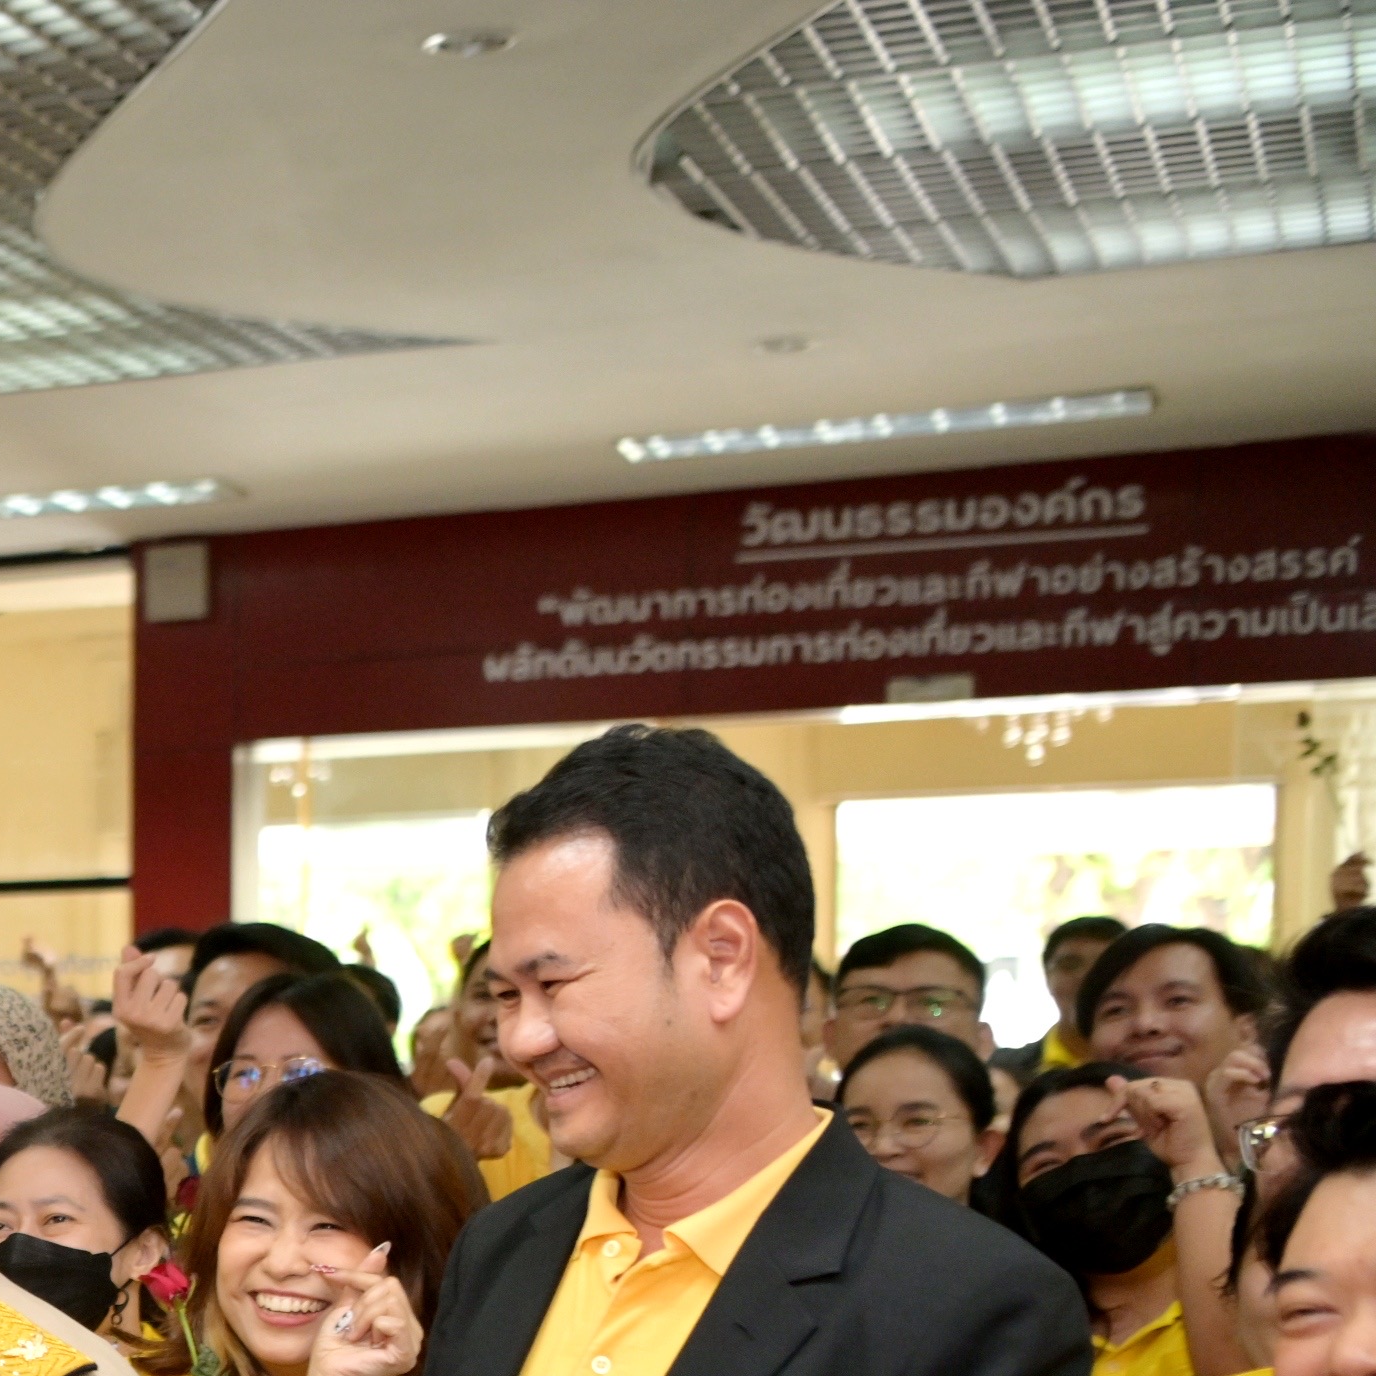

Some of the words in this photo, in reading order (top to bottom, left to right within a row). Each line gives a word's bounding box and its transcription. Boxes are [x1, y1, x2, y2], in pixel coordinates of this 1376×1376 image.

[740, 475, 1145, 548] วัฒนธรรมองค์กร
